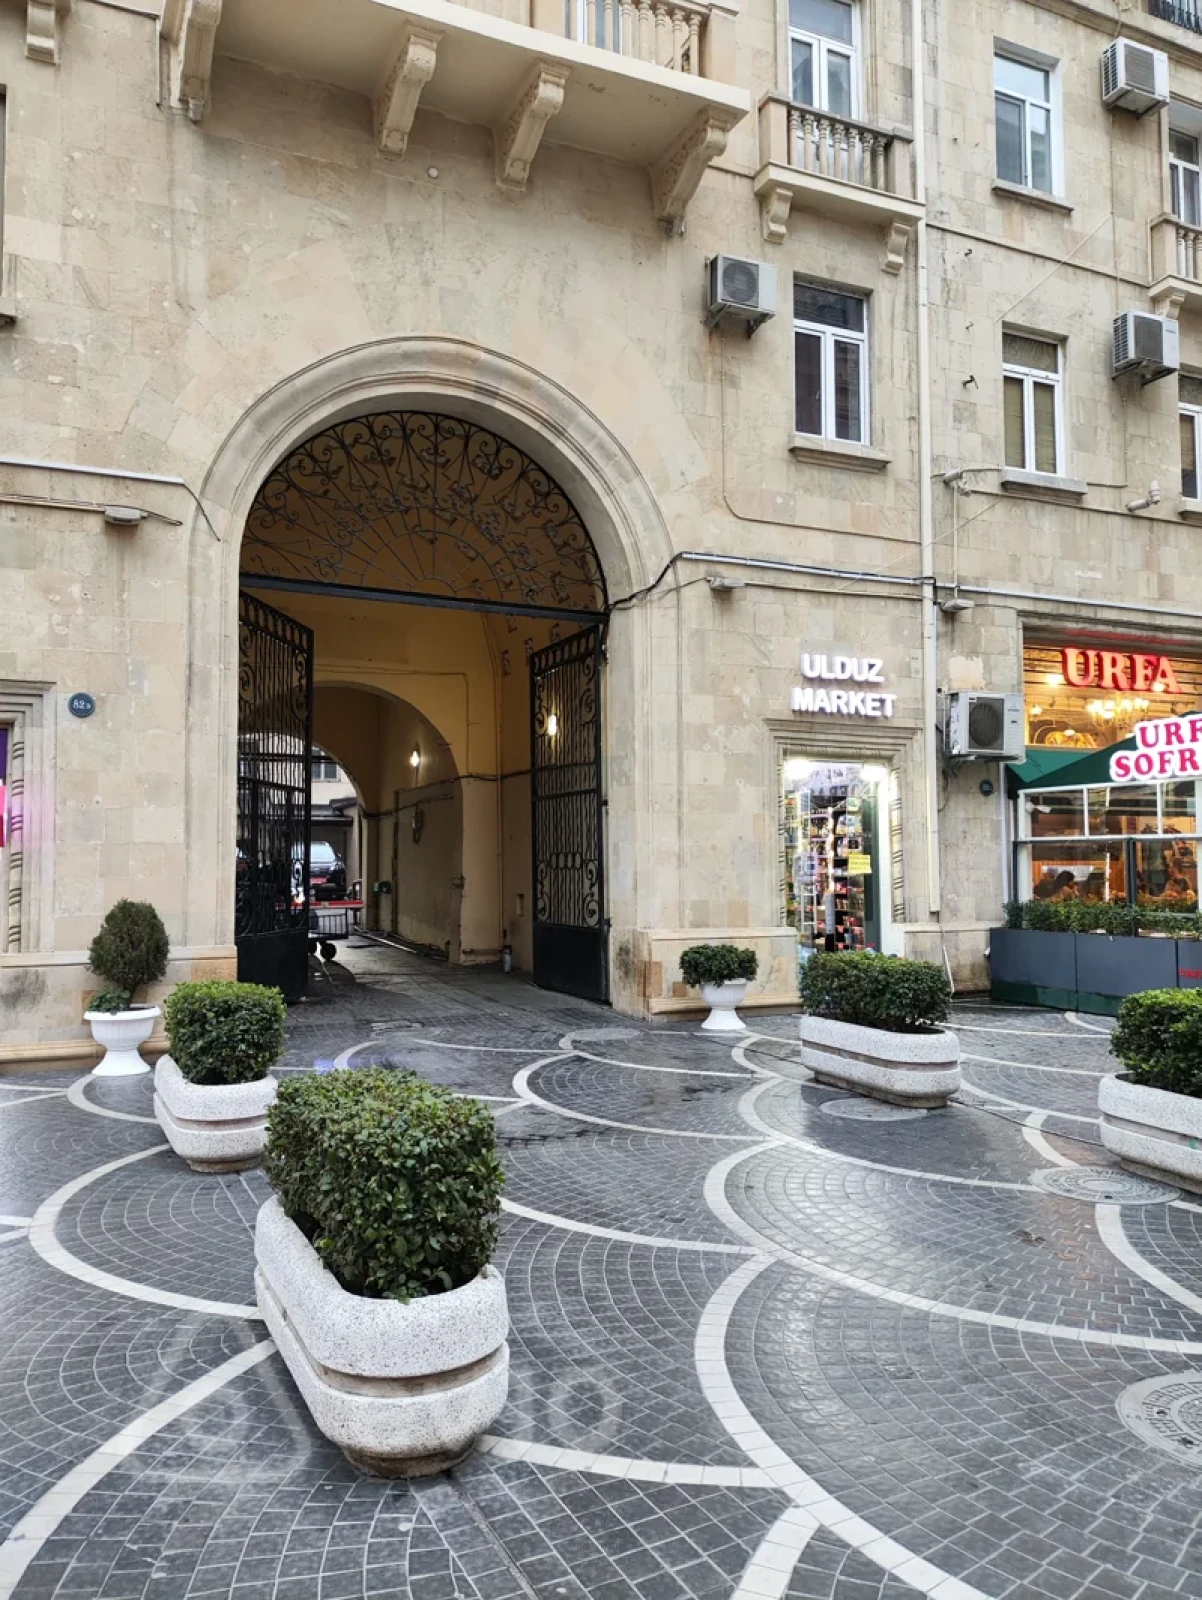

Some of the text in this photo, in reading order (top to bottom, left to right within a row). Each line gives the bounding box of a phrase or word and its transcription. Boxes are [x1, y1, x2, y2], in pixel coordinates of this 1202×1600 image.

[801, 653, 884, 683] ULDUZ
[1061, 648, 1182, 693] URFA
[790, 687, 897, 717] MARKET
